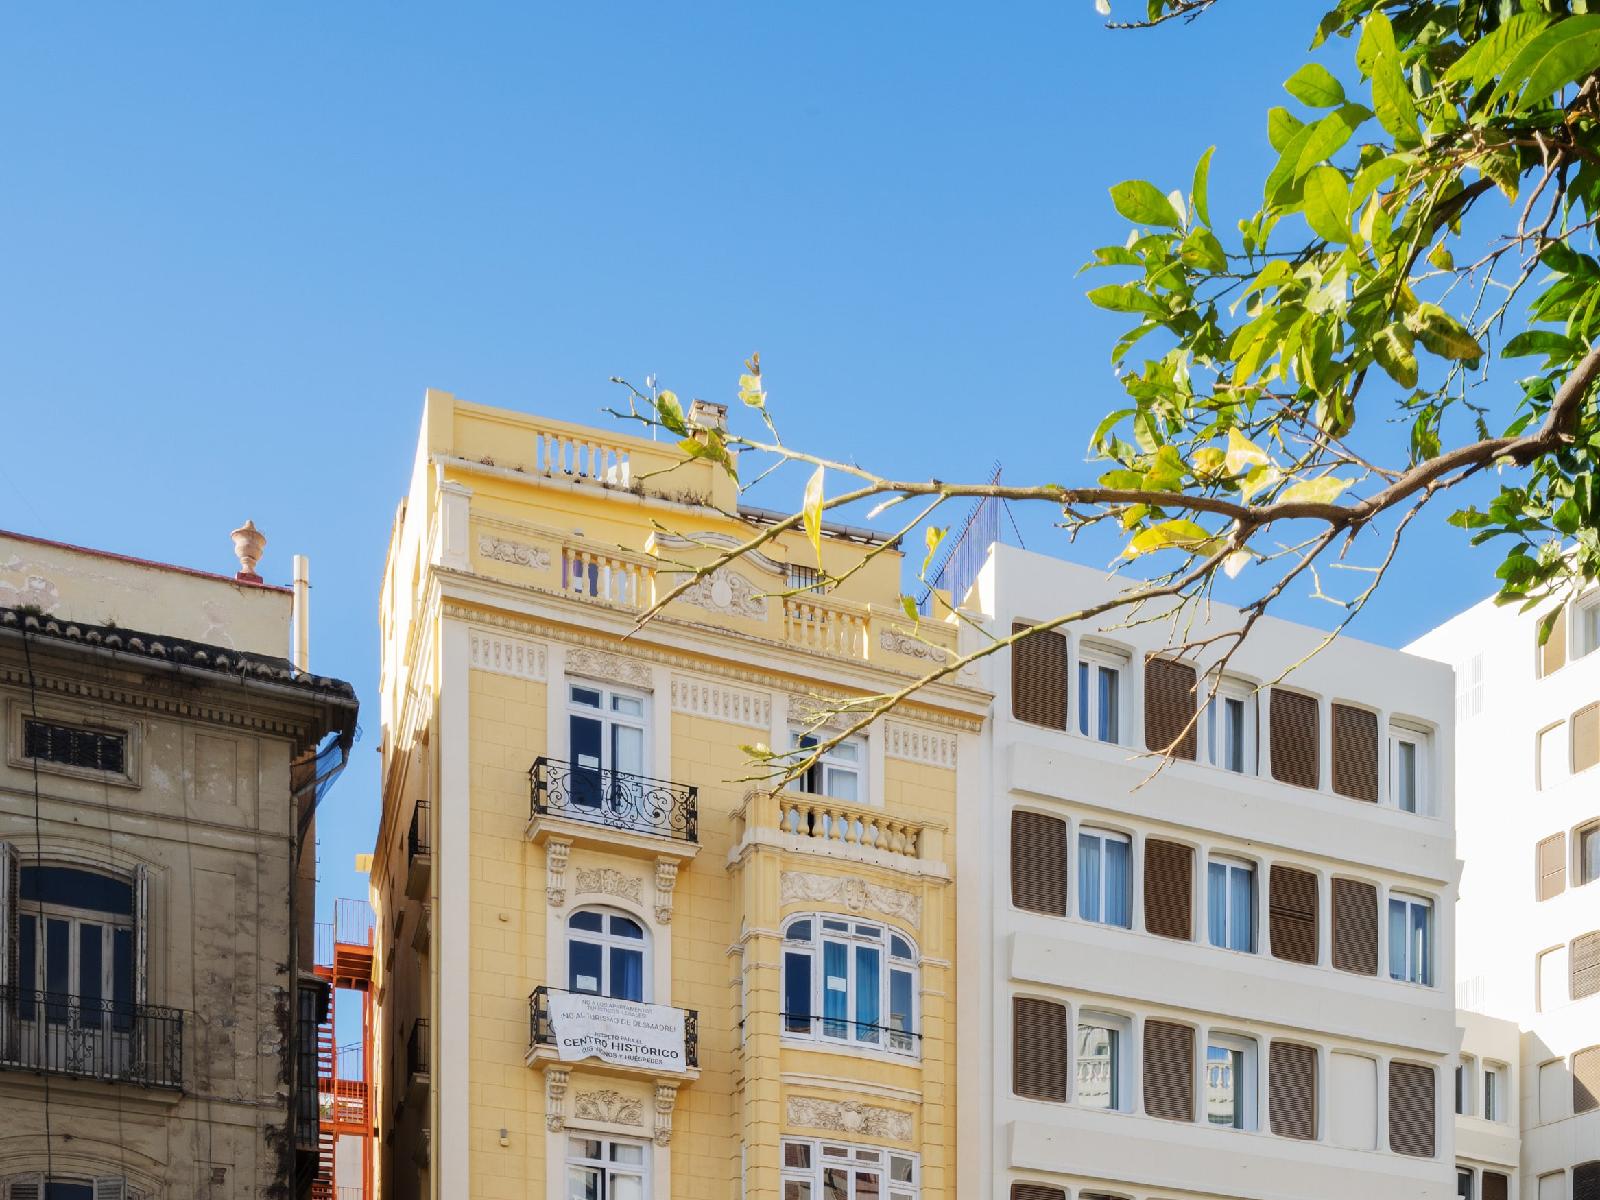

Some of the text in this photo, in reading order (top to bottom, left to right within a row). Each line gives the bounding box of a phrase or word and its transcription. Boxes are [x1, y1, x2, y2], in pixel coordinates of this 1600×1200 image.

[588, 1013, 620, 1024] TURISMO
[563, 1035, 680, 1060] CENTRO HISTÓRICO
